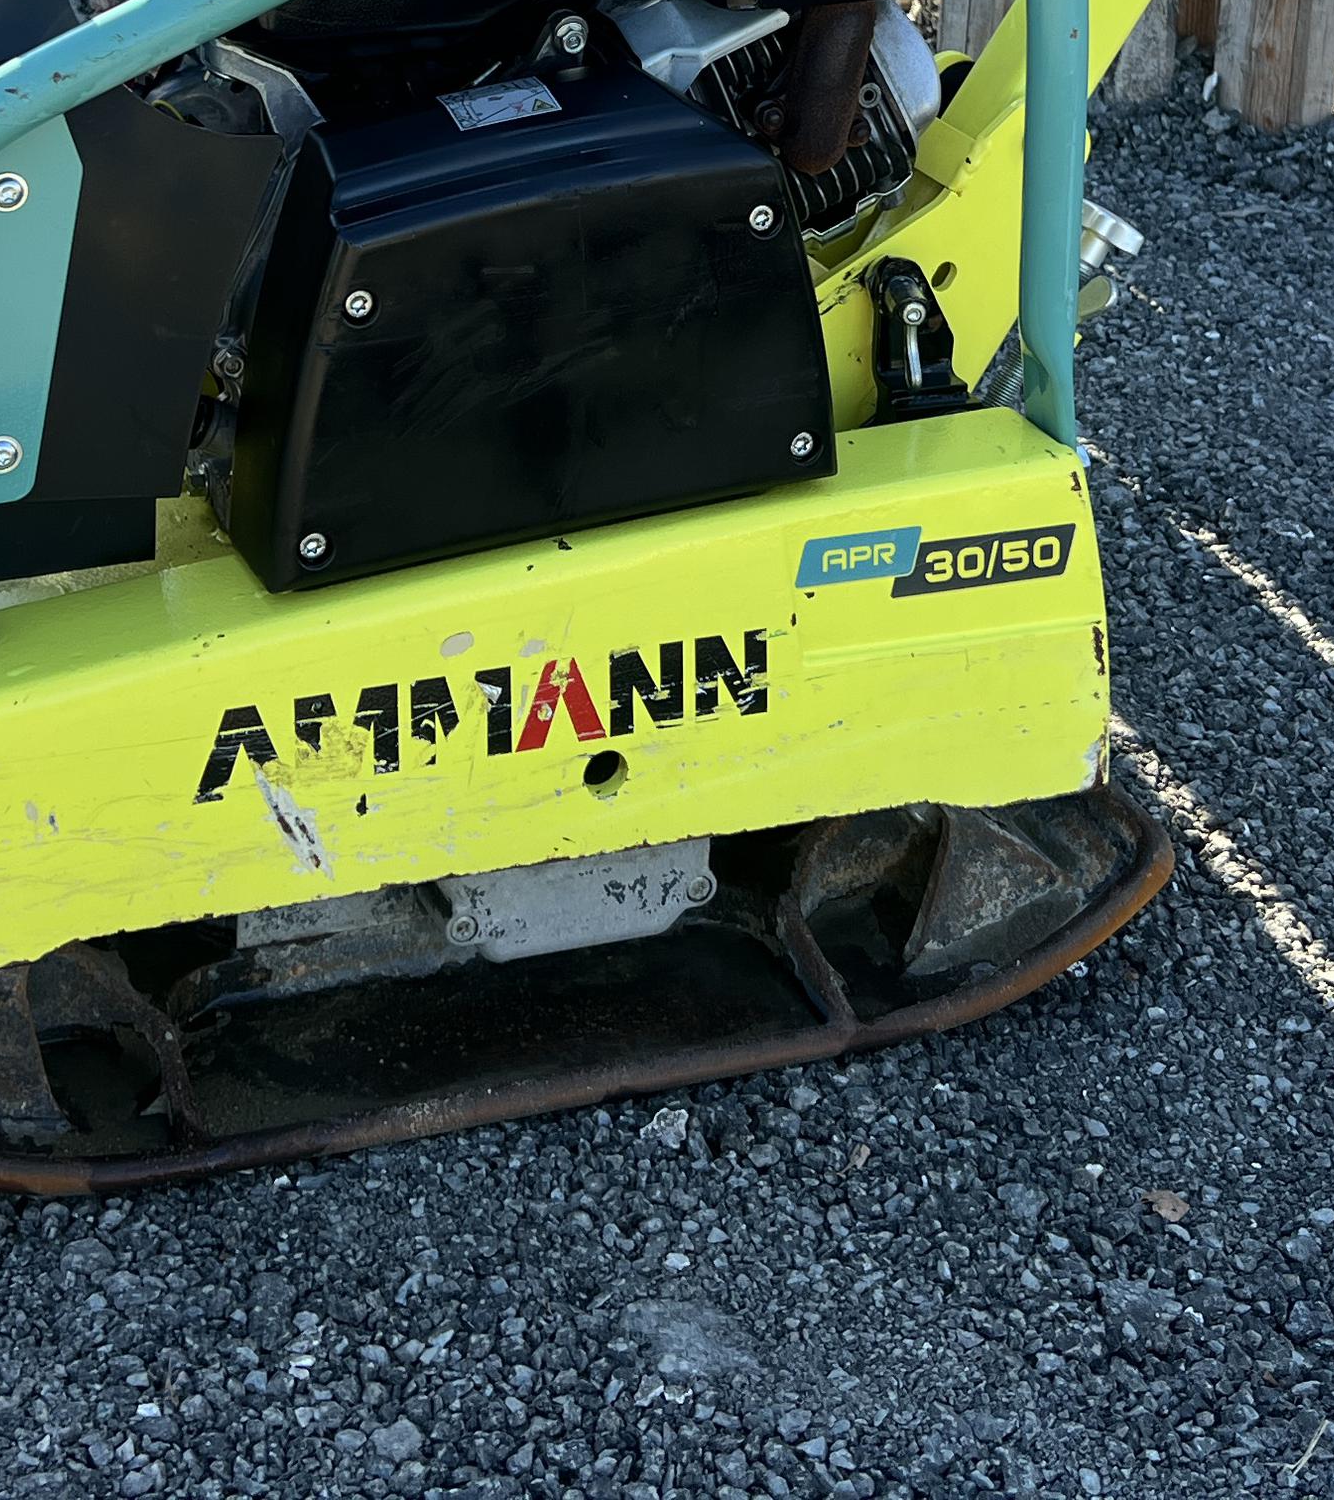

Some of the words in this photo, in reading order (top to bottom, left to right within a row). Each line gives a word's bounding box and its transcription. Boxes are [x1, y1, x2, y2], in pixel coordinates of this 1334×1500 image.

[821, 542, 897, 573] APR
[923, 535, 1062, 584] 30/50
[192, 628, 768, 805] AMMANN
